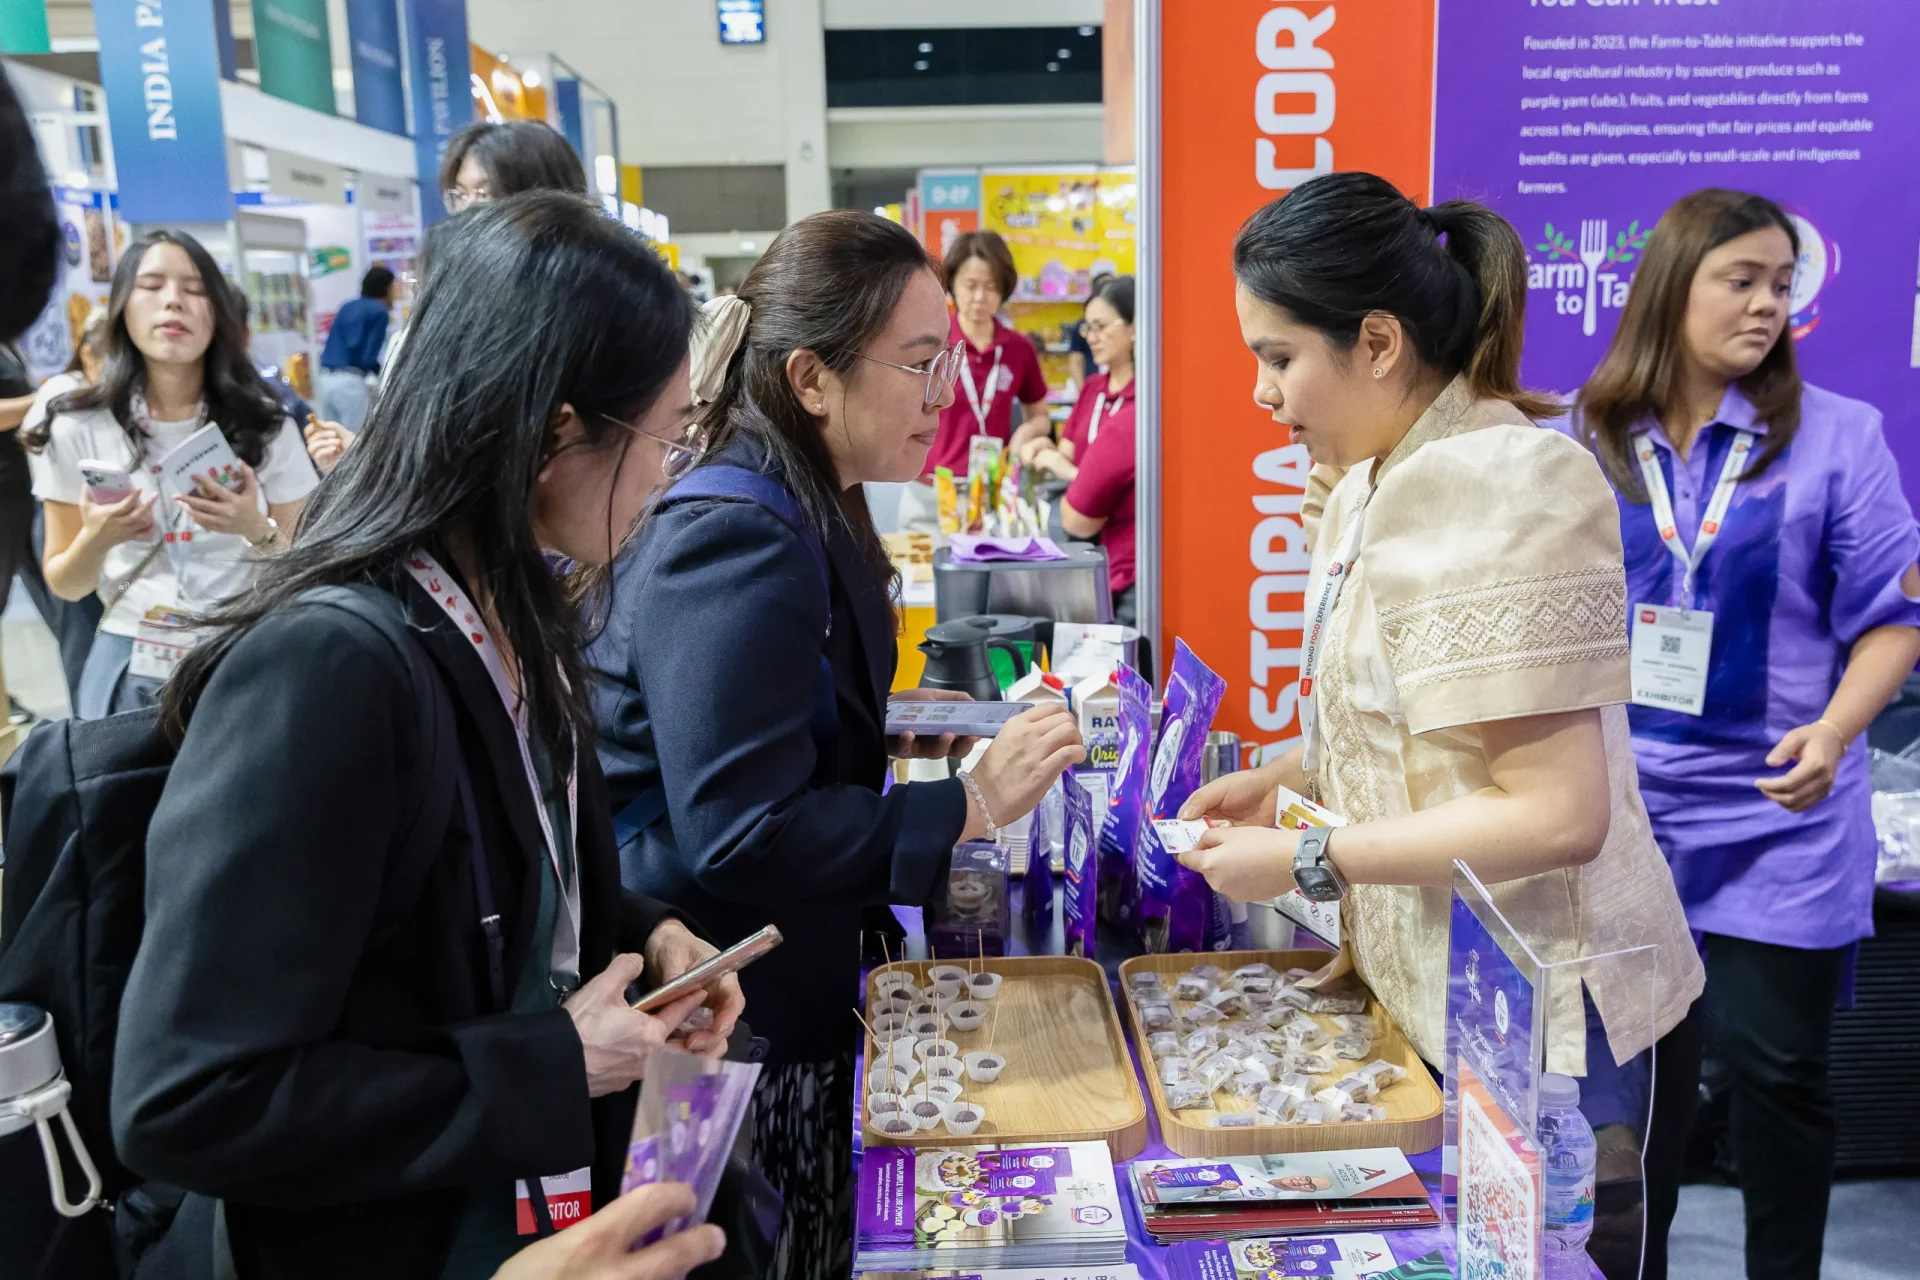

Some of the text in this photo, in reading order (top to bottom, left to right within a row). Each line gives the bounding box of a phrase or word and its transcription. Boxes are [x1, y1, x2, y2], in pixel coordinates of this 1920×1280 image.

[1524, 32, 1864, 51] Founded in 2023, the Farm-to-Table initiative supports the
[1522, 61, 1840, 81] local agricultural industry by sourcing produce such as
[140, 36, 177, 141] INDIA
[1255, 0, 1336, 190] COR
[1521, 90, 1869, 110] purple yam (ube), fruits, and vegetables directly from farms
[1520, 118, 1874, 138] across the Philippines, ensuring that fair prices and equitable
[1519, 147, 1861, 167] benefits are given, especially to small-scale and indigenous
[1518, 180, 1567, 194] farmers.
[1526, 256, 1585, 290] arm
[1597, 272, 1635, 308] Ta
[1555, 290, 1583, 315] to
[1315, 581, 1333, 624] EXPERIENCE
[1310, 623, 1321, 646] FOOD
[1306, 646, 1316, 676] BEYOND
[1637, 690, 1695, 706] EXHIBITOR
[896, 1170, 904, 1186] PURPLE
[1338, 1168, 1350, 1182] ACES
[1344, 1163, 1362, 1185] ASTORIA
[548, 1200, 580, 1220] SITOR
[895, 1206, 903, 1226] POWDER
